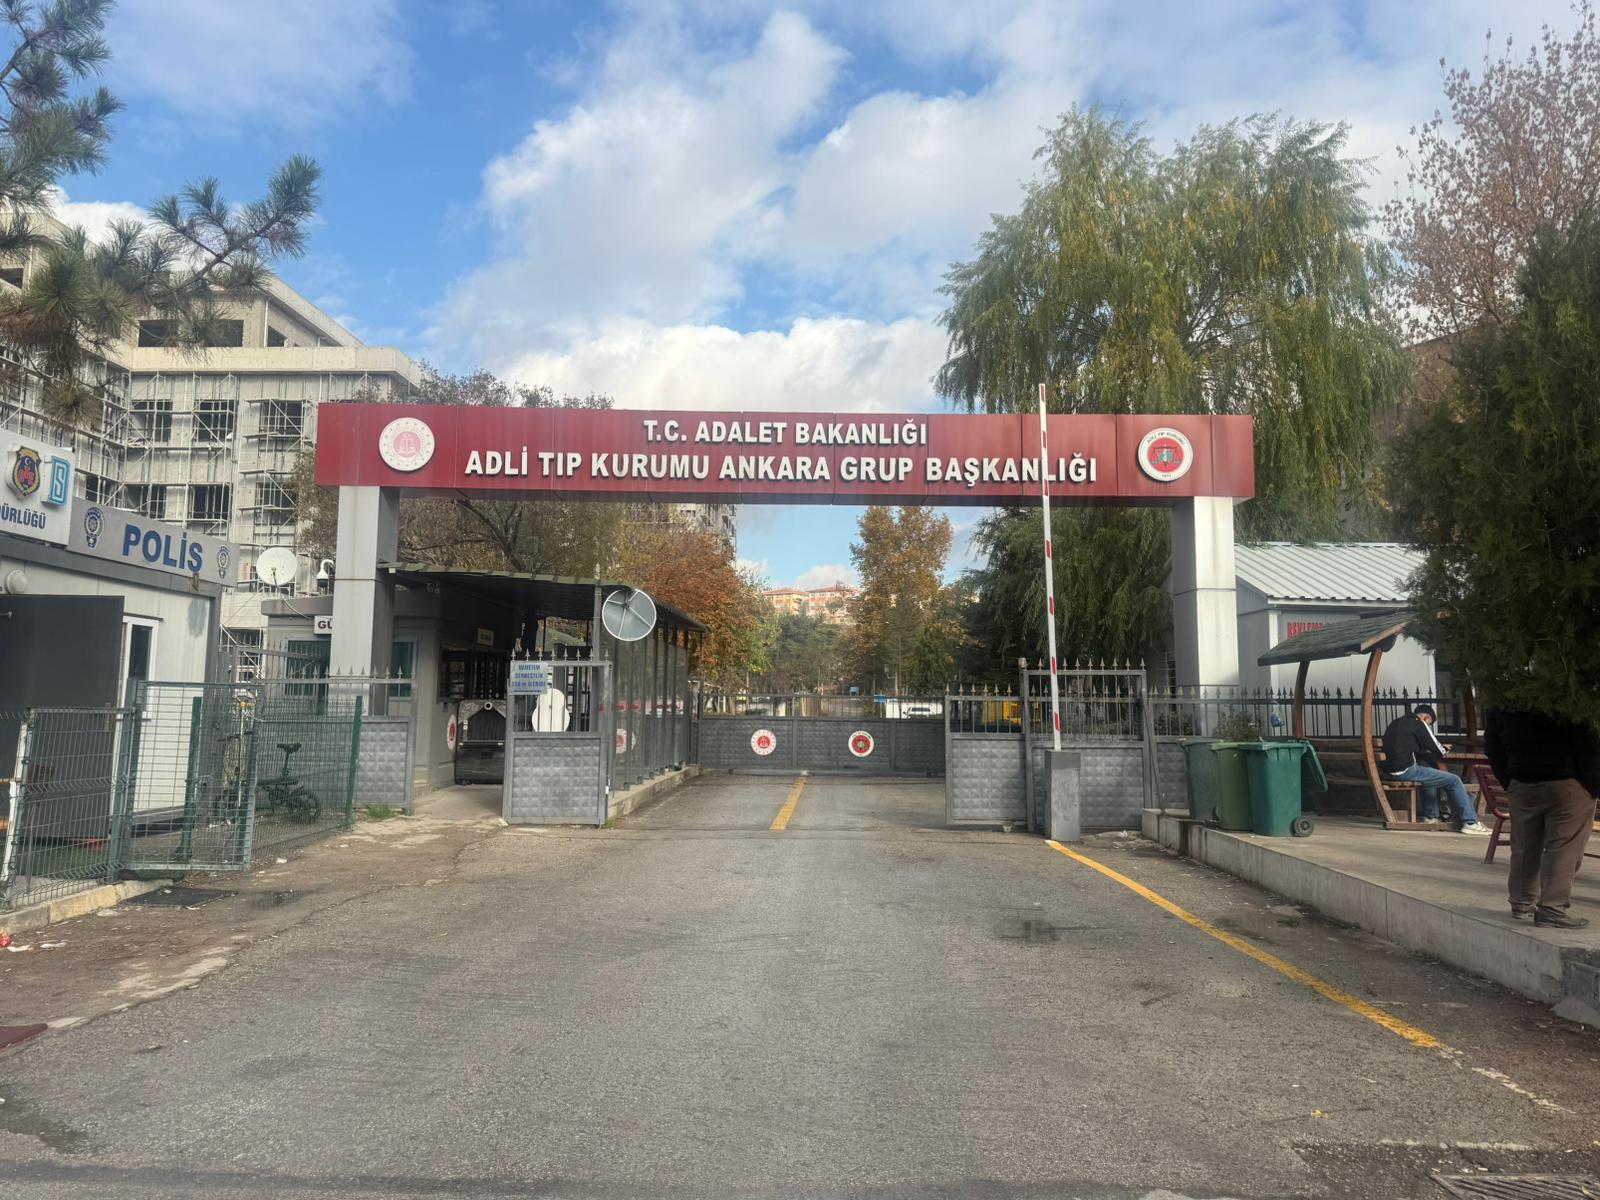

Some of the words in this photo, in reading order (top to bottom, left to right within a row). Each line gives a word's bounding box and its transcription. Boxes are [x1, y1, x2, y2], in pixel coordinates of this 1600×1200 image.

[644, 420, 686, 442] T.C.
[695, 421, 786, 443] ADALET
[795, 418, 926, 444] BAKANLIĞI
[465, 446, 528, 476] ADLİ
[539, 452, 582, 477] TIP
[591, 453, 709, 480] KURUMU
[719, 455, 830, 481] ANKARA
[840, 456, 913, 482] GRUP
[0, 502, 46, 529] ÜRLÜĞÜ
[122, 523, 203, 573] POLİS
